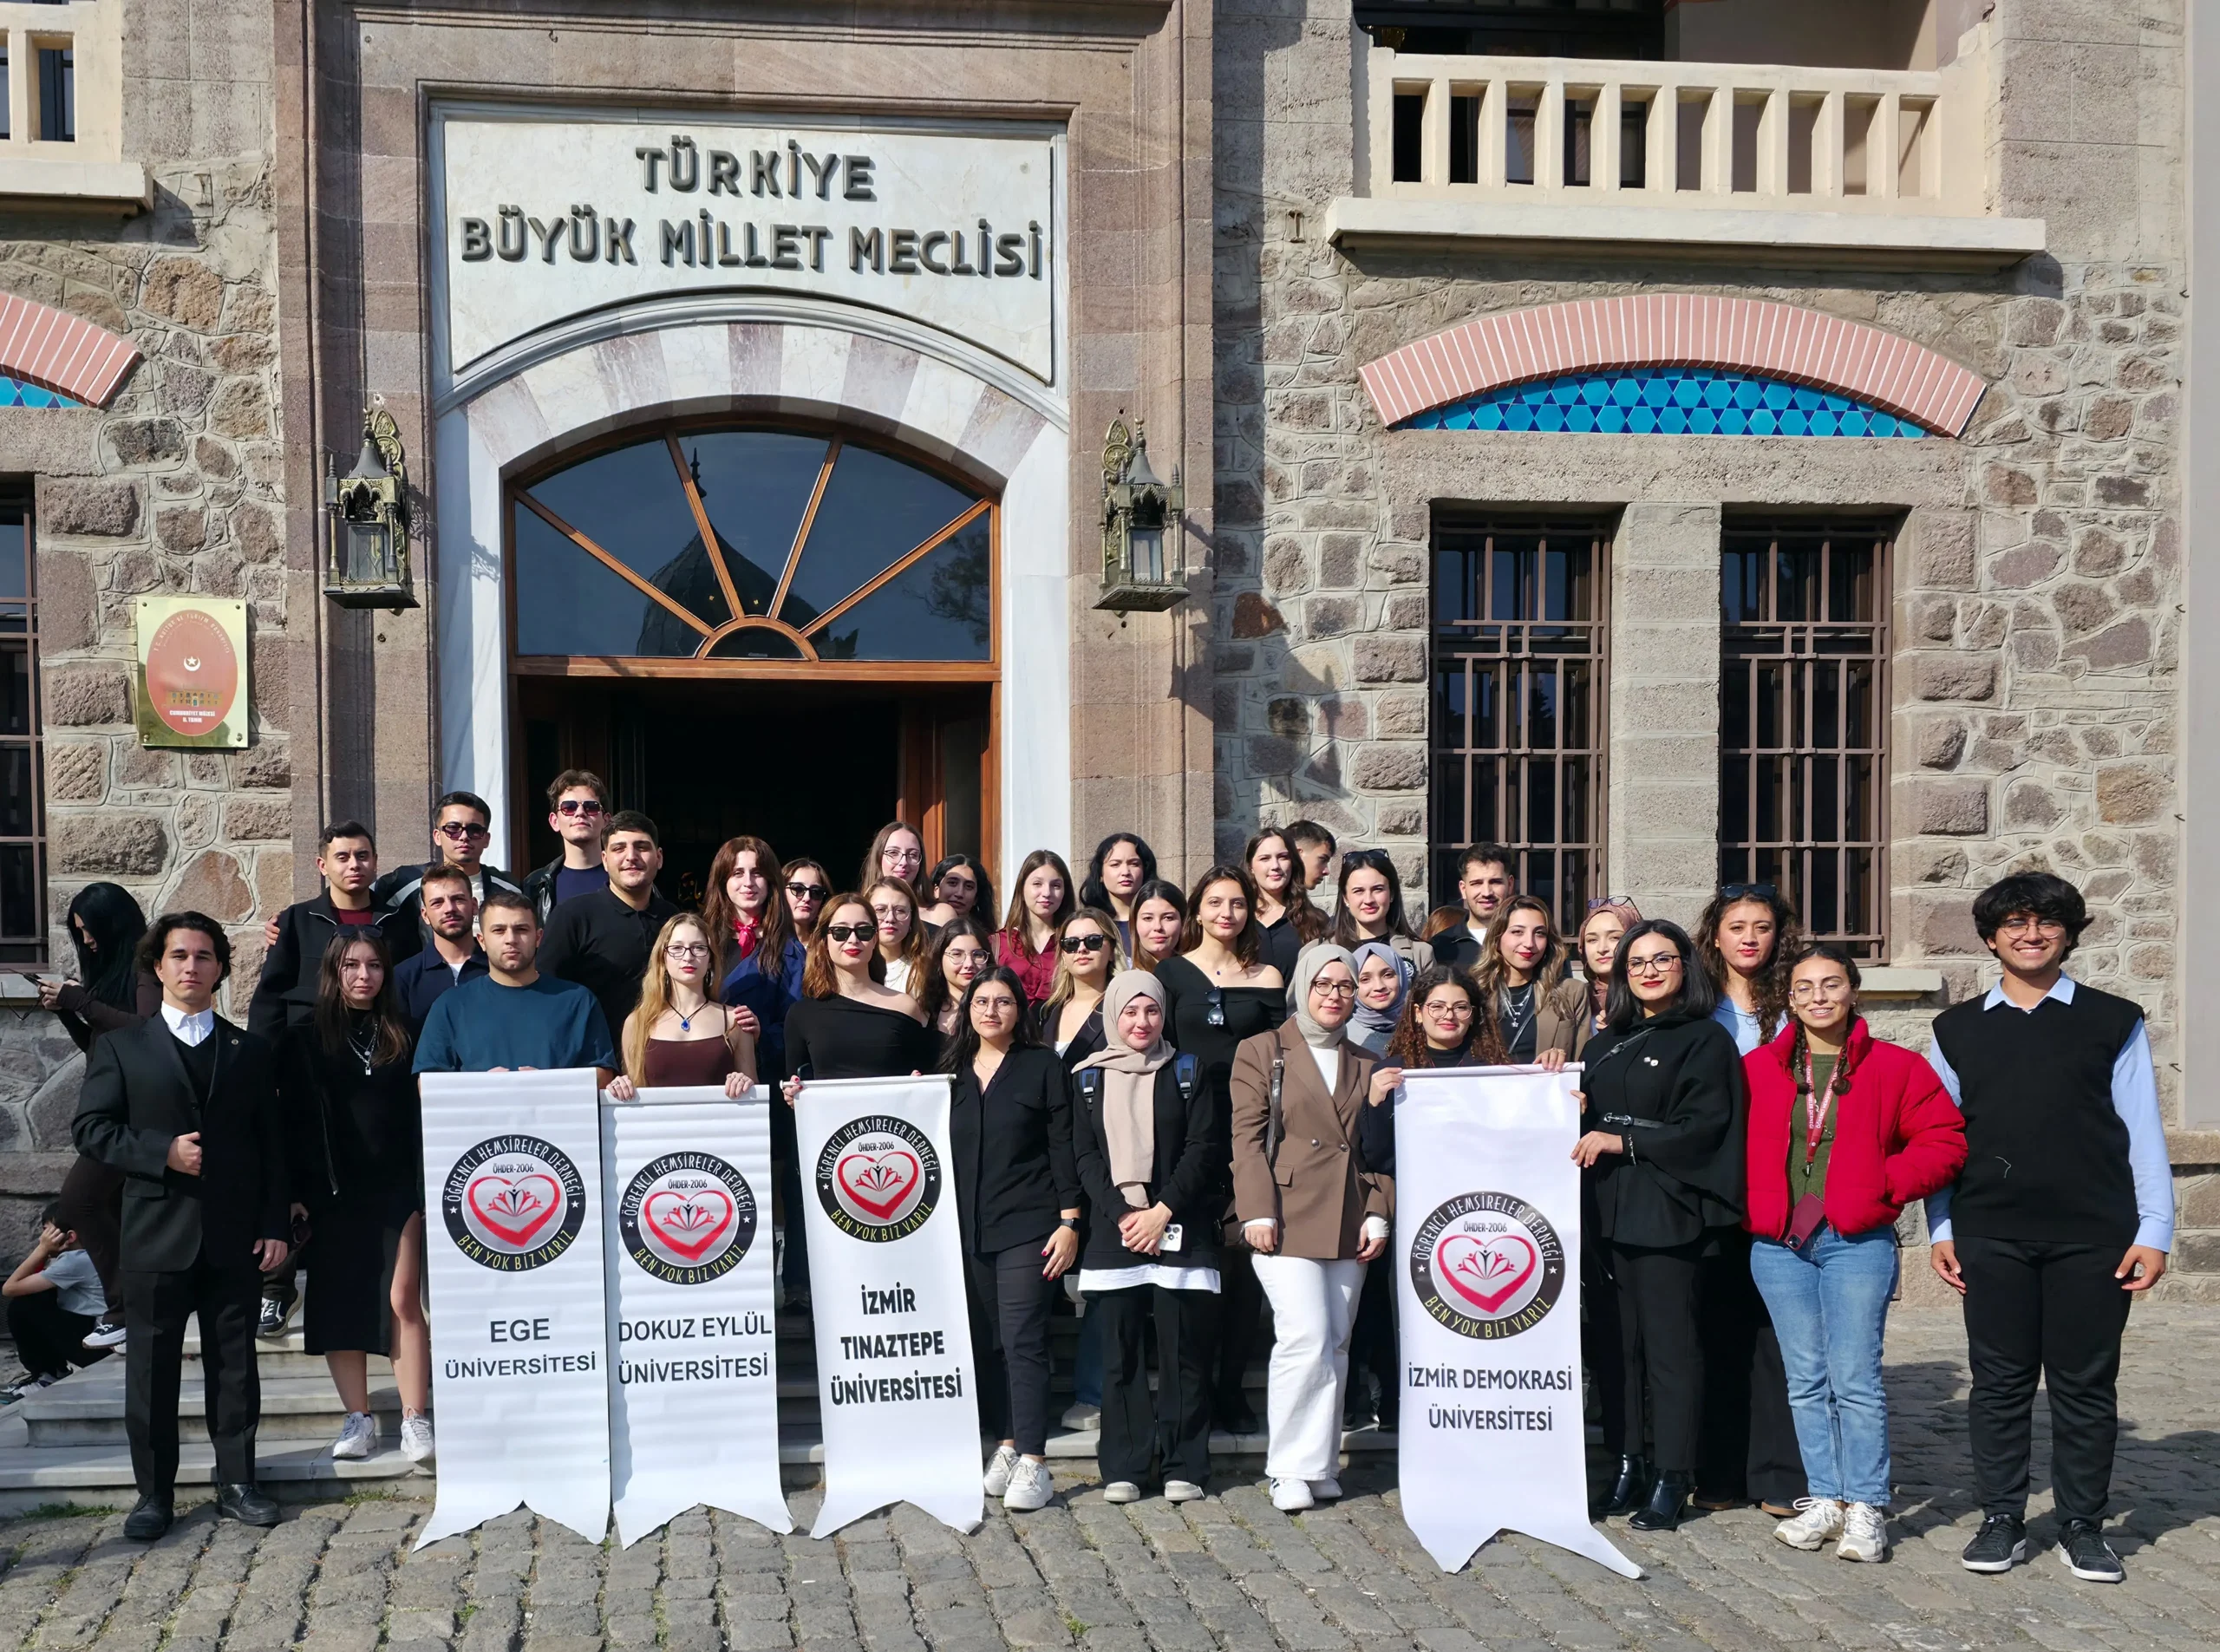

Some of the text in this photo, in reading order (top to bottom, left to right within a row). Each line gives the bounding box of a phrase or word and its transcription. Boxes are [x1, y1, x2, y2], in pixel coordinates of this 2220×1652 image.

[636, 134, 877, 201] TÜRKİYE
[460, 204, 1043, 278] BÜYÜK MİLLET MECLİSİ
[817, 1116, 939, 1179] ÖĞRENCİ HEMŞİRELER DERNEĞİ
[858, 1142, 895, 1152] ÖHDER-2006
[444, 1135, 584, 1202] ÖĞRENCİ HEMŞİRELER DERNEĞİ
[493, 1163, 534, 1174] ÖHDER-2006
[621, 1152, 755, 1216] ÖĞRENCİ HEMŞİRELER DERNEĞİ
[668, 1179, 708, 1190] ÖHDER-2006
[831, 1201, 933, 1241] BEN YOK BİZ VARIZ
[1412, 1192, 1563, 1262] ÖĞRENCİ HEMŞİRELER DERNEĞİ
[1464, 1221, 1507, 1233] ÖHDER-2006
[457, 1230, 574, 1270] BEN YOK BİZ VARIZ
[633, 1244, 746, 1283] BEN YOK BİZ VARIZ
[861, 1282, 917, 1315] İZMİR
[490, 1318, 551, 1343] EGE
[618, 1311, 773, 1342] DOKUZ EYLÜL
[1425, 1296, 1551, 1338] BEN YOK BİZ VARIZ
[840, 1330, 945, 1360] TINAZTEPE
[445, 1351, 597, 1379] ÜNİVERSİTESİ
[618, 1352, 768, 1385] ÜNİVERSİTESİ
[1408, 1361, 1572, 1390] İZMİR DEMOKRASİ
[831, 1367, 963, 1406] ÜNİVERSİTESİ
[1429, 1403, 1552, 1431] ÜNİVERSİTESİ
